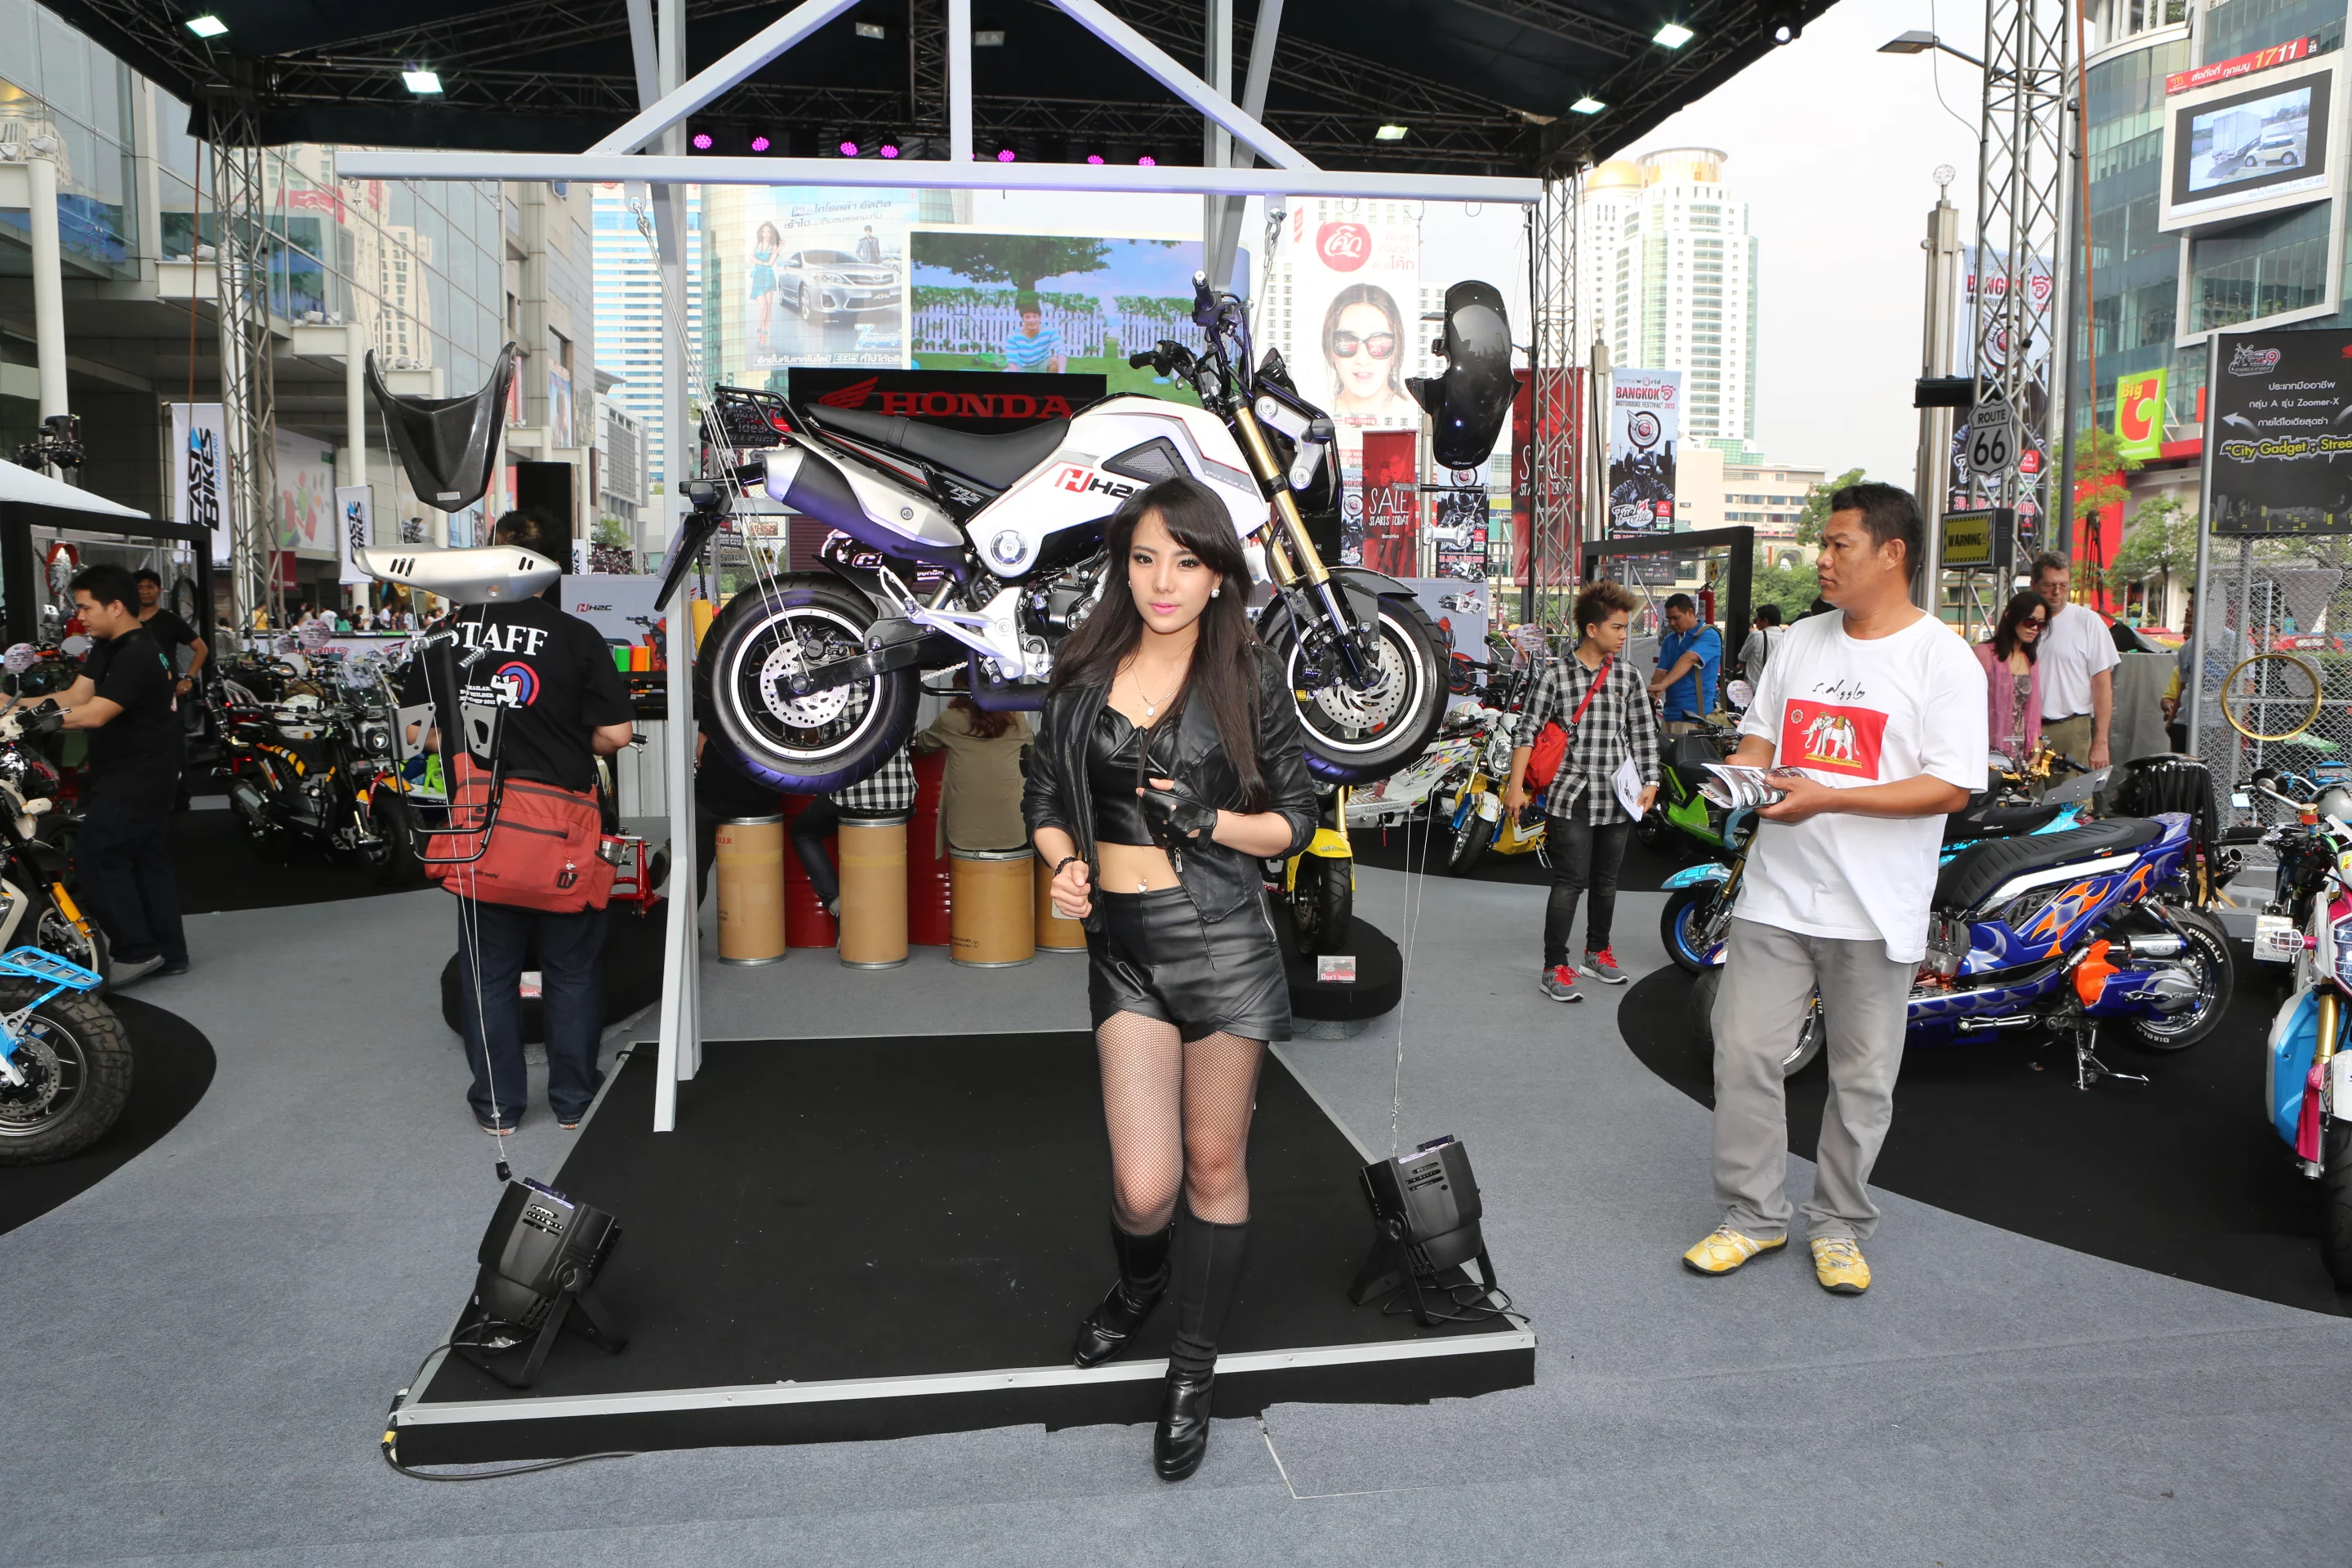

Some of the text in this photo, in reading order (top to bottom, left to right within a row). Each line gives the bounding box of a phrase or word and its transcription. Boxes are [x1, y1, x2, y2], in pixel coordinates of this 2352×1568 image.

[2255, 41, 2298, 69] 1711
[1615, 386, 1659, 400] BANGKOK
[2121, 381, 2143, 401] Big
[2268, 381, 2336, 390] ประเภทมืออาชีพ
[879, 392, 1074, 418] HONDA
[2121, 379, 2160, 443] C
[2249, 399, 2268, 409] กลุ่ม
[2281, 399, 2294, 408] รุ่น
[2297, 397, 2340, 407] Zoomer-X
[1977, 409, 2006, 424] ROUTE
[1973, 428, 2007, 466] 66
[2260, 441, 2306, 455] Gadget
[2321, 439, 2352, 448] Stree
[212, 432, 222, 491] THAILAND
[199, 426, 220, 532] BIKES
[1088, 478, 1138, 499] H2
[1205, 470, 1252, 492] SPICE YOUR RIDE
[1369, 488, 1409, 515] SALE
[1369, 515, 1409, 527] STARTS TODAY
[1361, 802, 1403, 813] HONDA
[474, 869, 499, 880] acsafe
[2187, 927, 2224, 964] PIRELLI
[2136, 1026, 2169, 1043] DIABLO
